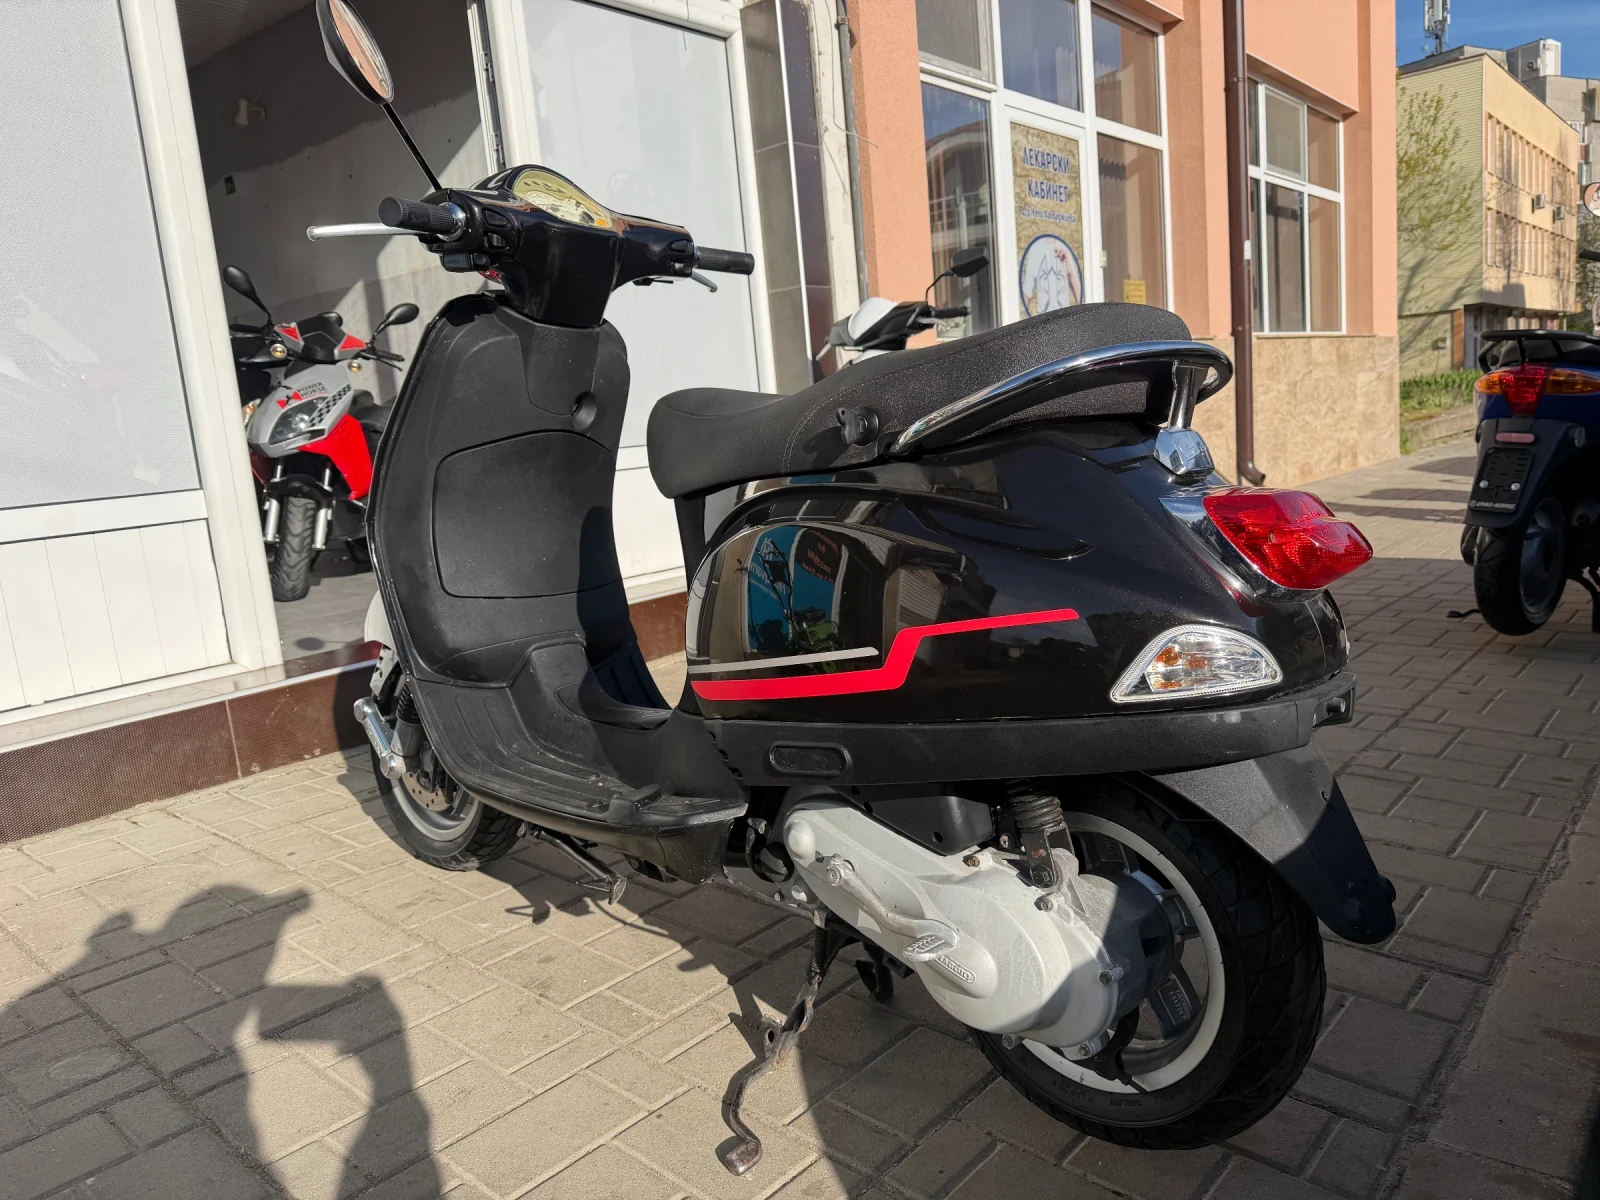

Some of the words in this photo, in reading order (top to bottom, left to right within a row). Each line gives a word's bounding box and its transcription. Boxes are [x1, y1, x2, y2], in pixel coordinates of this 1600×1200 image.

[1023, 147, 1070, 174] ЛЕКАРСКИ
[1027, 179, 1069, 203] КАБИНЕТ
[297, 382, 323, 393] POWER
[300, 386, 327, 397] HORSE
